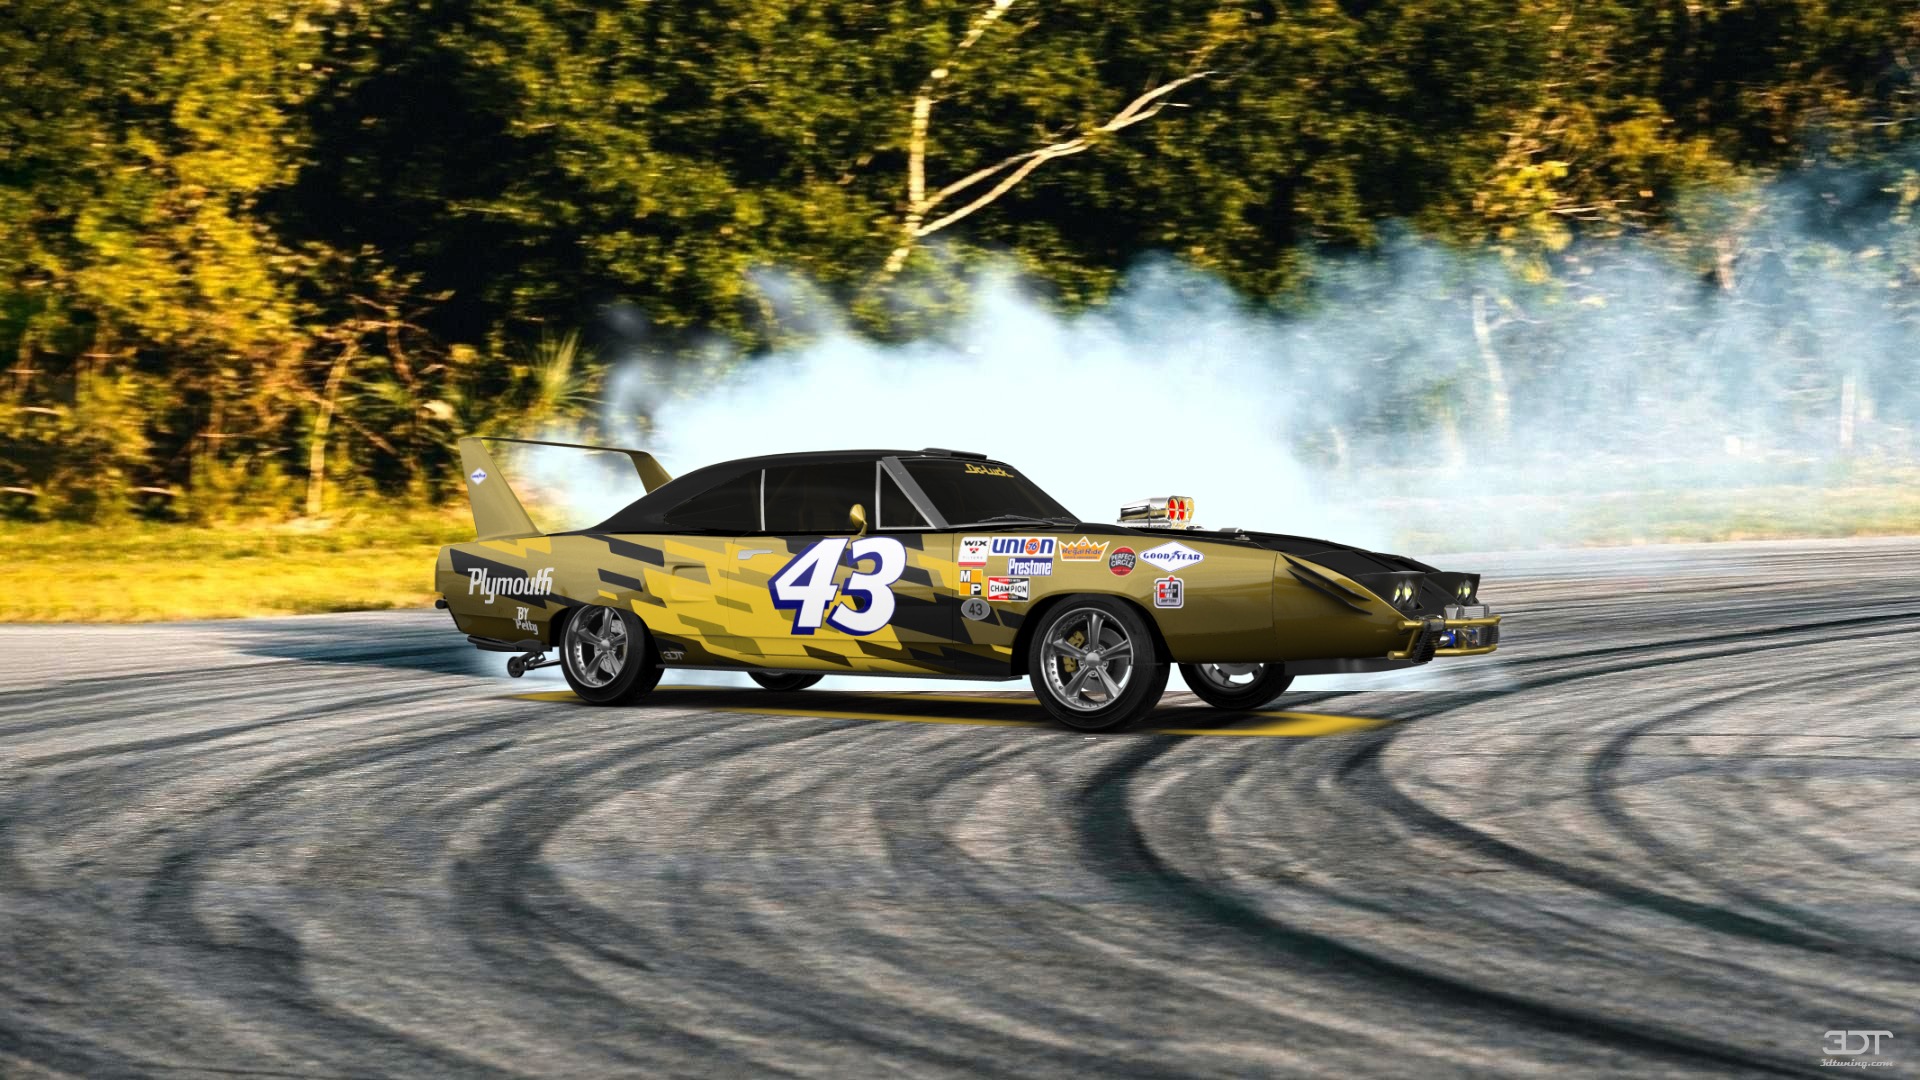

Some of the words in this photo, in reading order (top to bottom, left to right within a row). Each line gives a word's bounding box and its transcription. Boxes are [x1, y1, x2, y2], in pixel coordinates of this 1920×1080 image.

[1027, 542, 1038, 551] 76
[1110, 559, 1134, 568] CIRCLE
[1111, 553, 1135, 562] PERFECT
[1008, 558, 1052, 576] Prestone
[960, 570, 971, 582] M
[467, 567, 554, 604] Plymouth
[768, 537, 907, 636] 43
[971, 584, 981, 595] P
[990, 585, 1027, 593] CHAMPION
[516, 606, 529, 620] BY
[968, 603, 983, 616] 43
[513, 618, 538, 635] Petty
